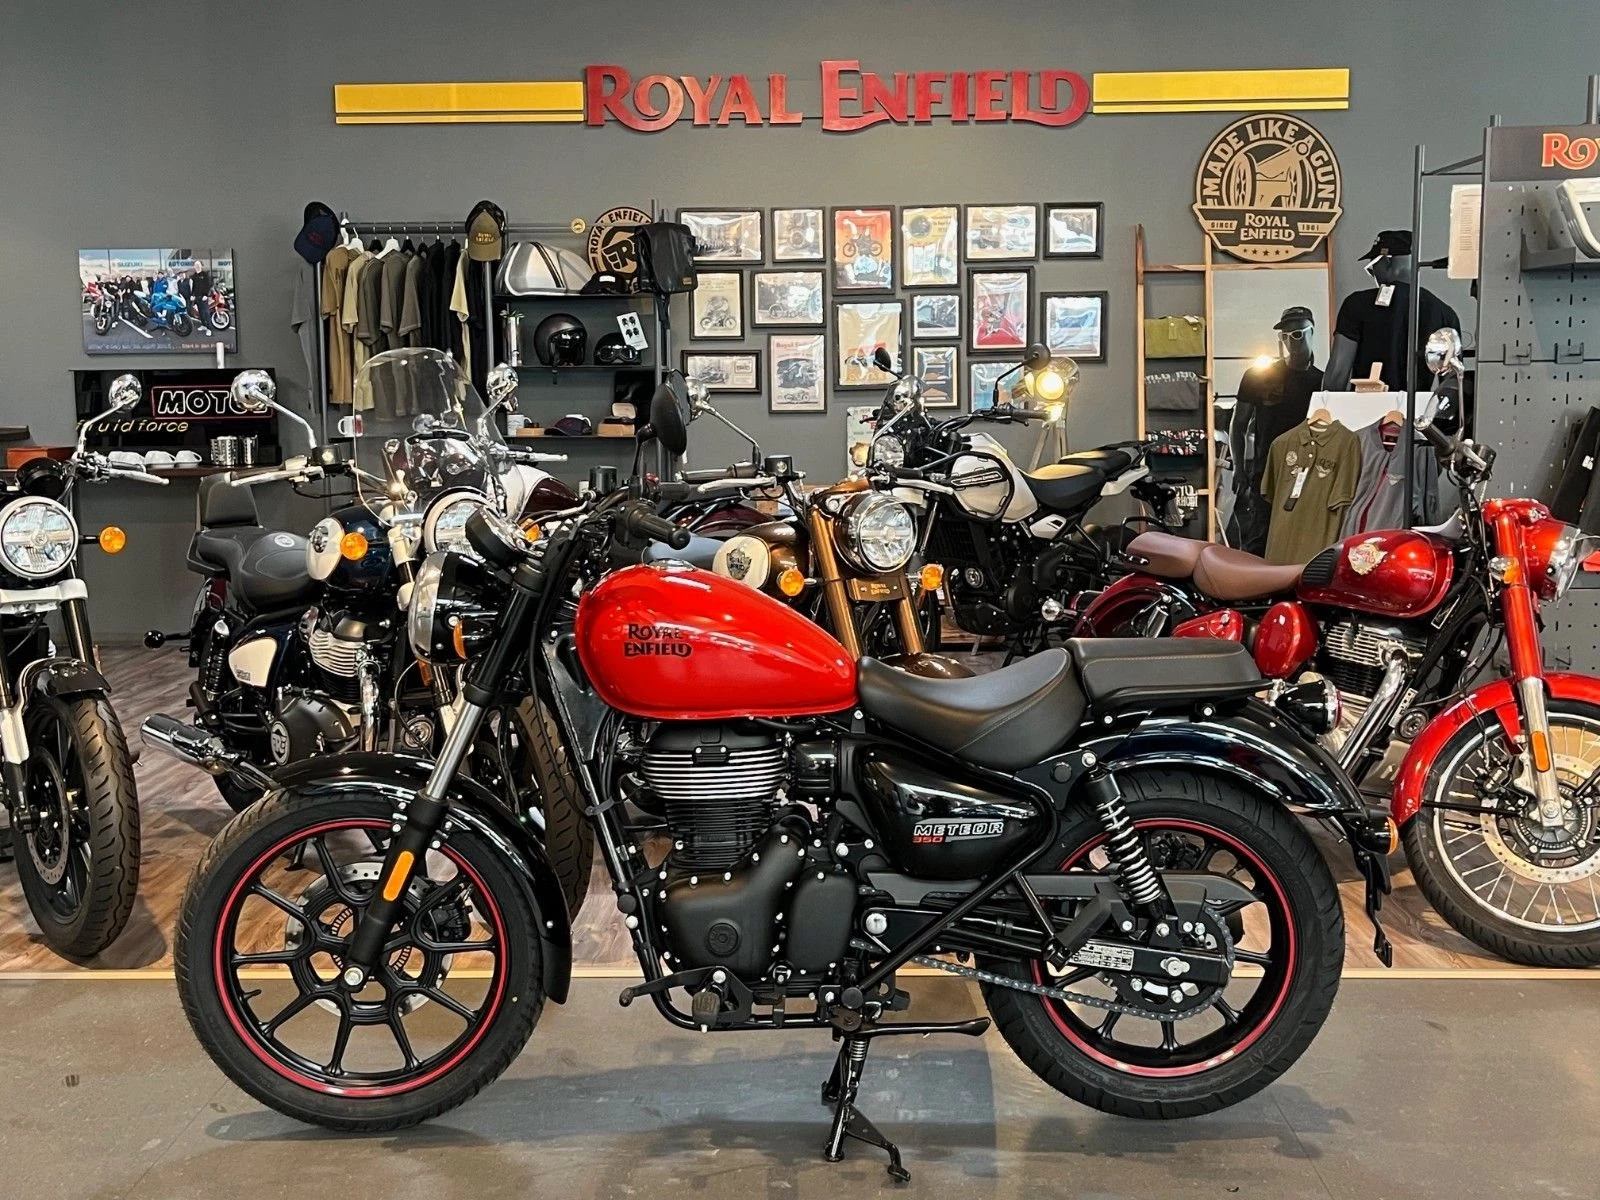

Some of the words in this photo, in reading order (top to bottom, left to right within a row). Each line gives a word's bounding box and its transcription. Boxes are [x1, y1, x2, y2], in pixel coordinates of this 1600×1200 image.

[584, 65, 804, 132] ROYAL
[821, 59, 1092, 132] ENFIELD
[1203, 131, 1245, 196] MADE
[1245, 119, 1300, 142] LIKE
[1310, 149, 1336, 199] GUN
[1541, 133, 1600, 170] RO
[1245, 213, 1290, 228] ROYAL
[1240, 227, 1296, 242] ENFIELD
[138, 419, 189, 433] force
[628, 623, 684, 640] ROYAL
[624, 641, 692, 657] ENFIELD
[913, 821, 1004, 836] METEOR
